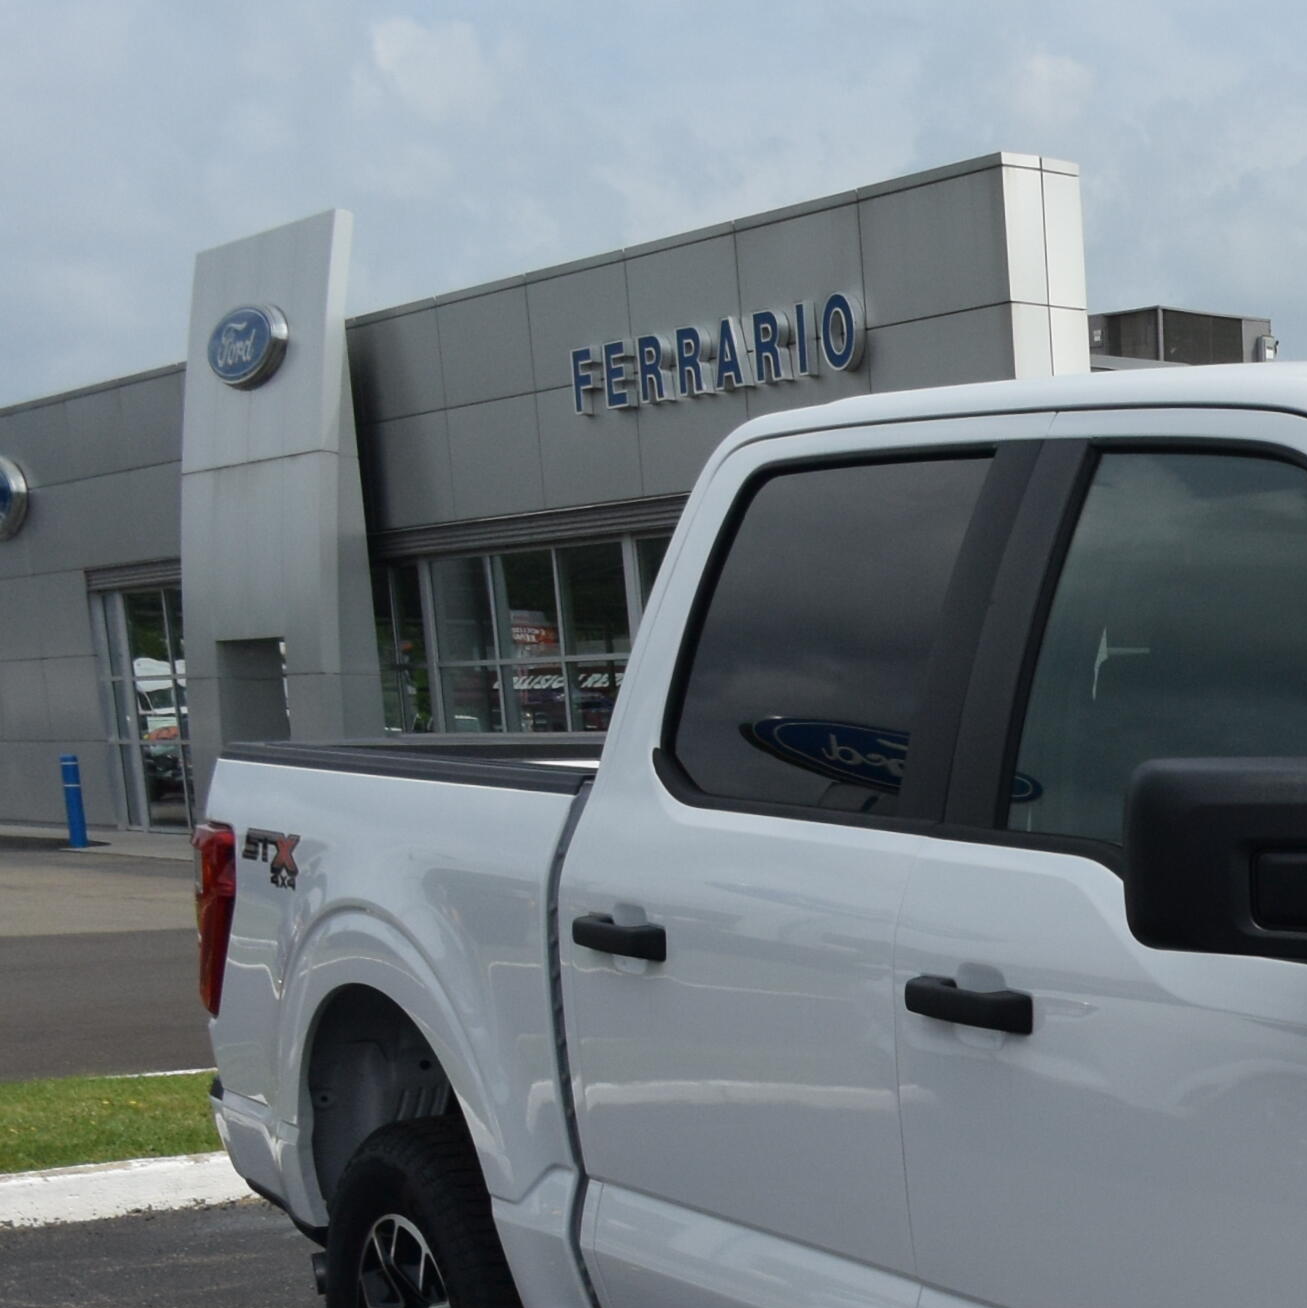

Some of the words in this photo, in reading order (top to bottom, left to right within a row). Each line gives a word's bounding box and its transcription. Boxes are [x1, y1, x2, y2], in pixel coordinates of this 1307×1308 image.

[216, 320, 256, 368] Ford
[570, 293, 862, 416] FERRARIO
[242, 827, 301, 877] STX
